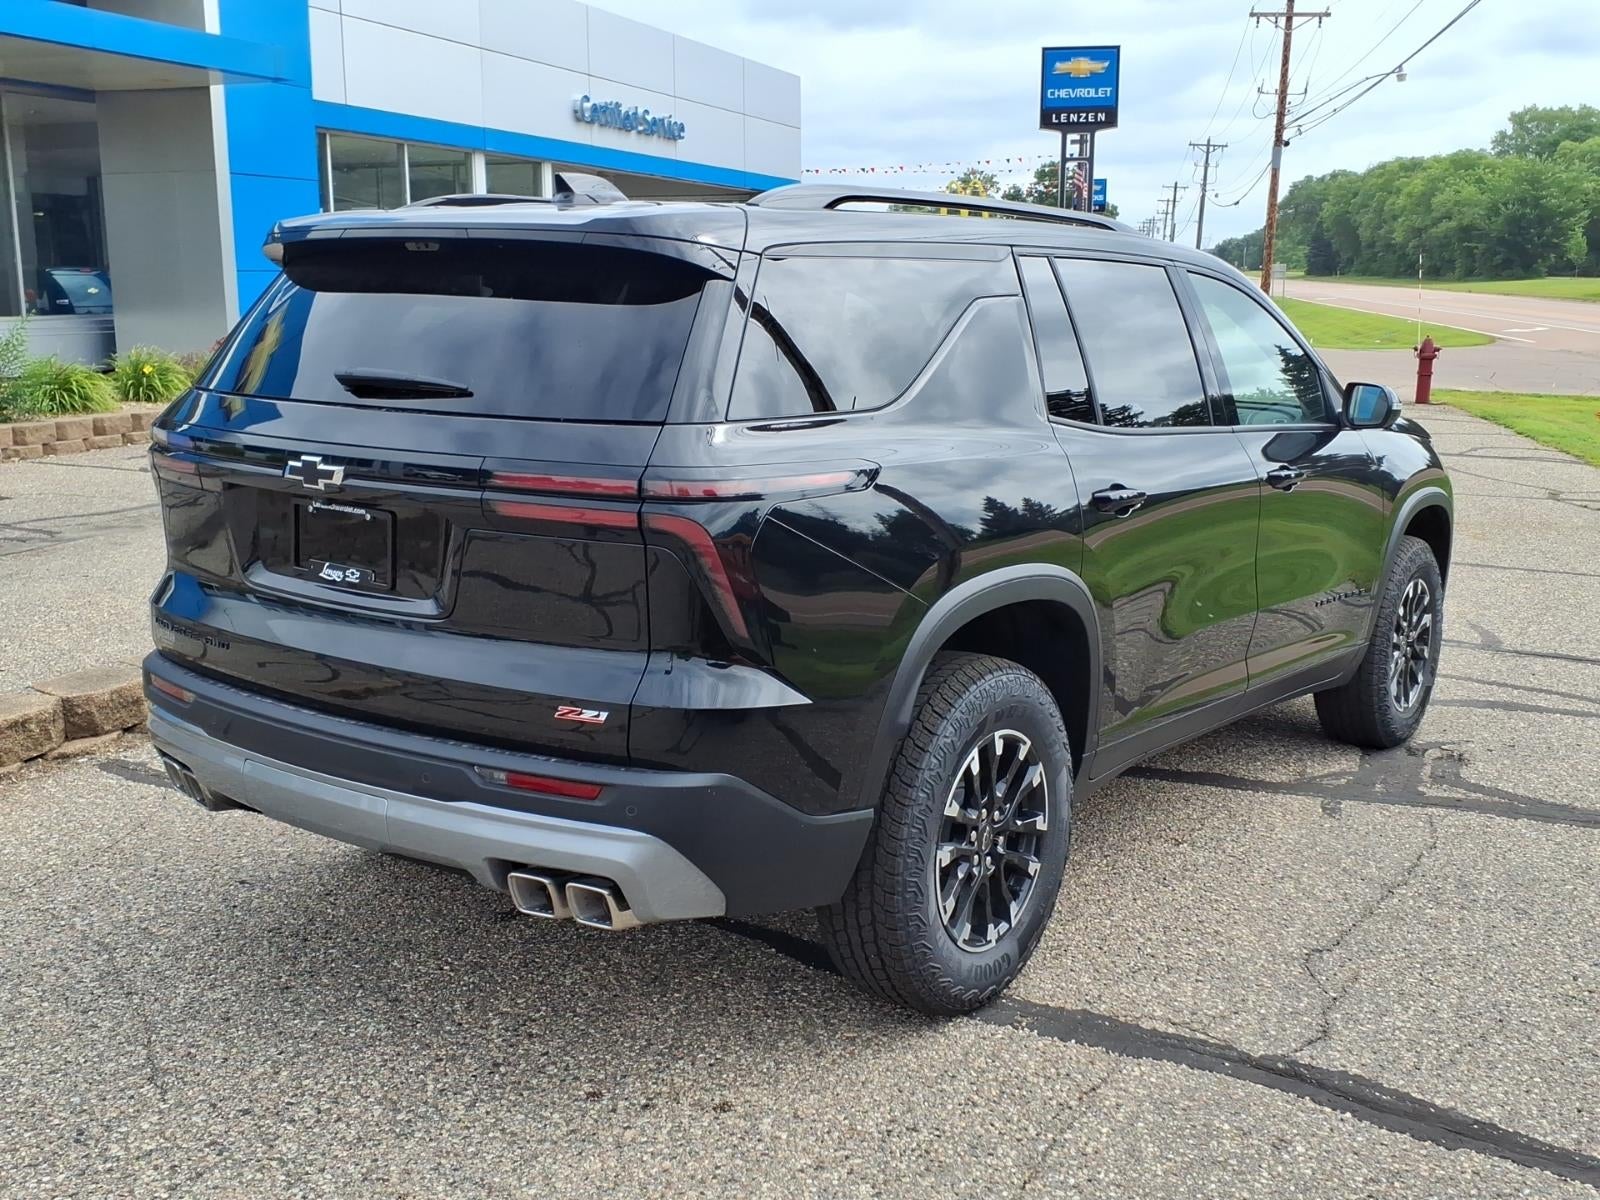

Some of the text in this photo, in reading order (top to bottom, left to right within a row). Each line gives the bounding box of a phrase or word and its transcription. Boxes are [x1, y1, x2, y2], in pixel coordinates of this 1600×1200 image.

[1047, 87, 1112, 99] CHEVROLET
[575, 94, 685, 141] Certified Service
[1052, 112, 1106, 123] LENZEN
[554, 705, 609, 724] Z71
